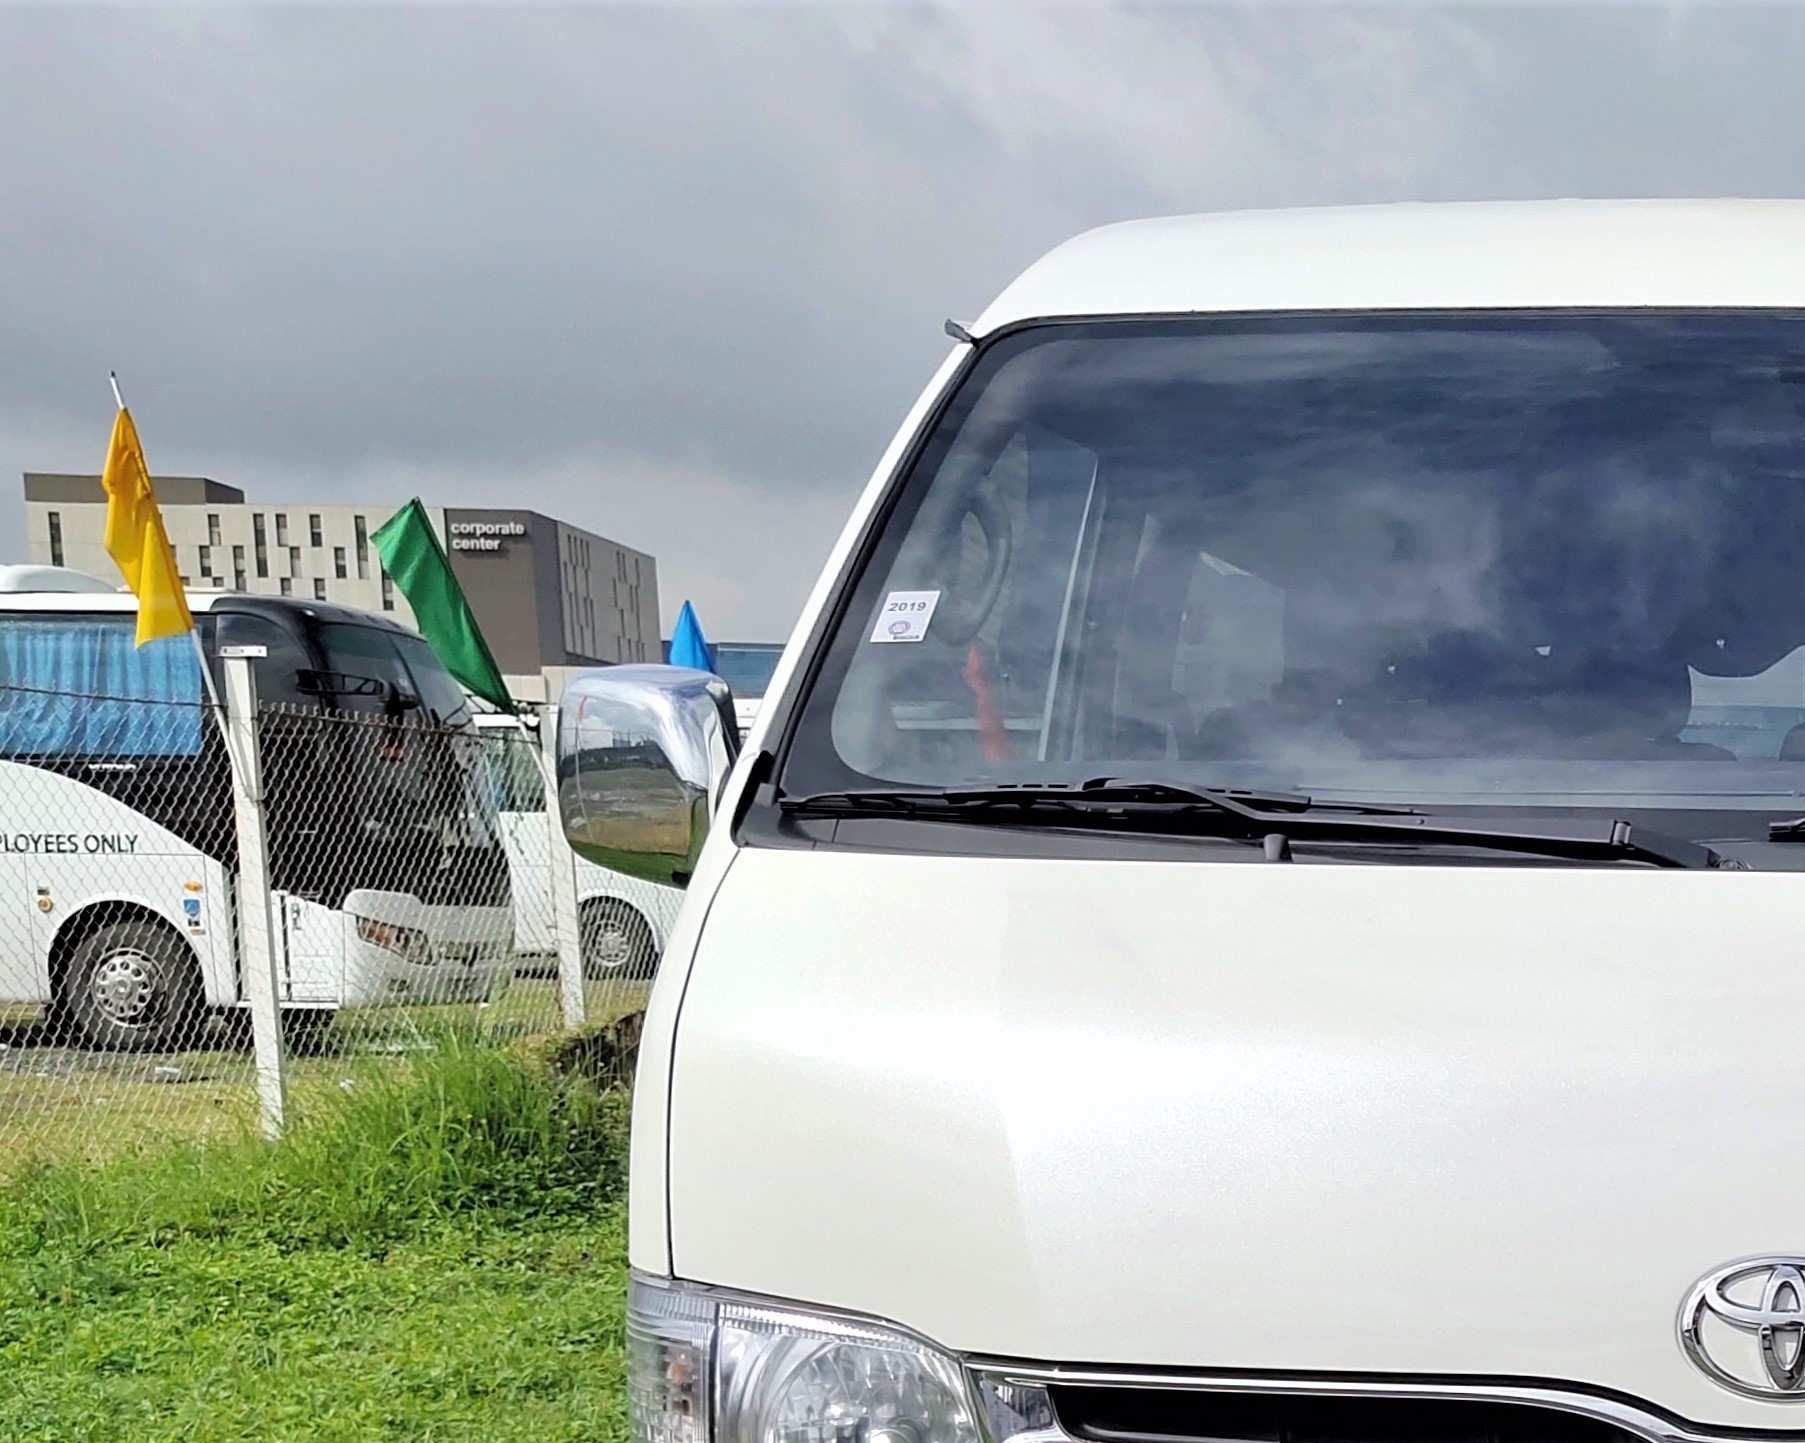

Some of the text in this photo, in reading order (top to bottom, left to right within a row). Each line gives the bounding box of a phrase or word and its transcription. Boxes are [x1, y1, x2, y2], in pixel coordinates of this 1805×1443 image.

[450, 521, 525, 537] corporate
[452, 537, 501, 551] center
[887, 601, 927, 612] 2019
[0, 833, 139, 853] LOYEES ONLY
